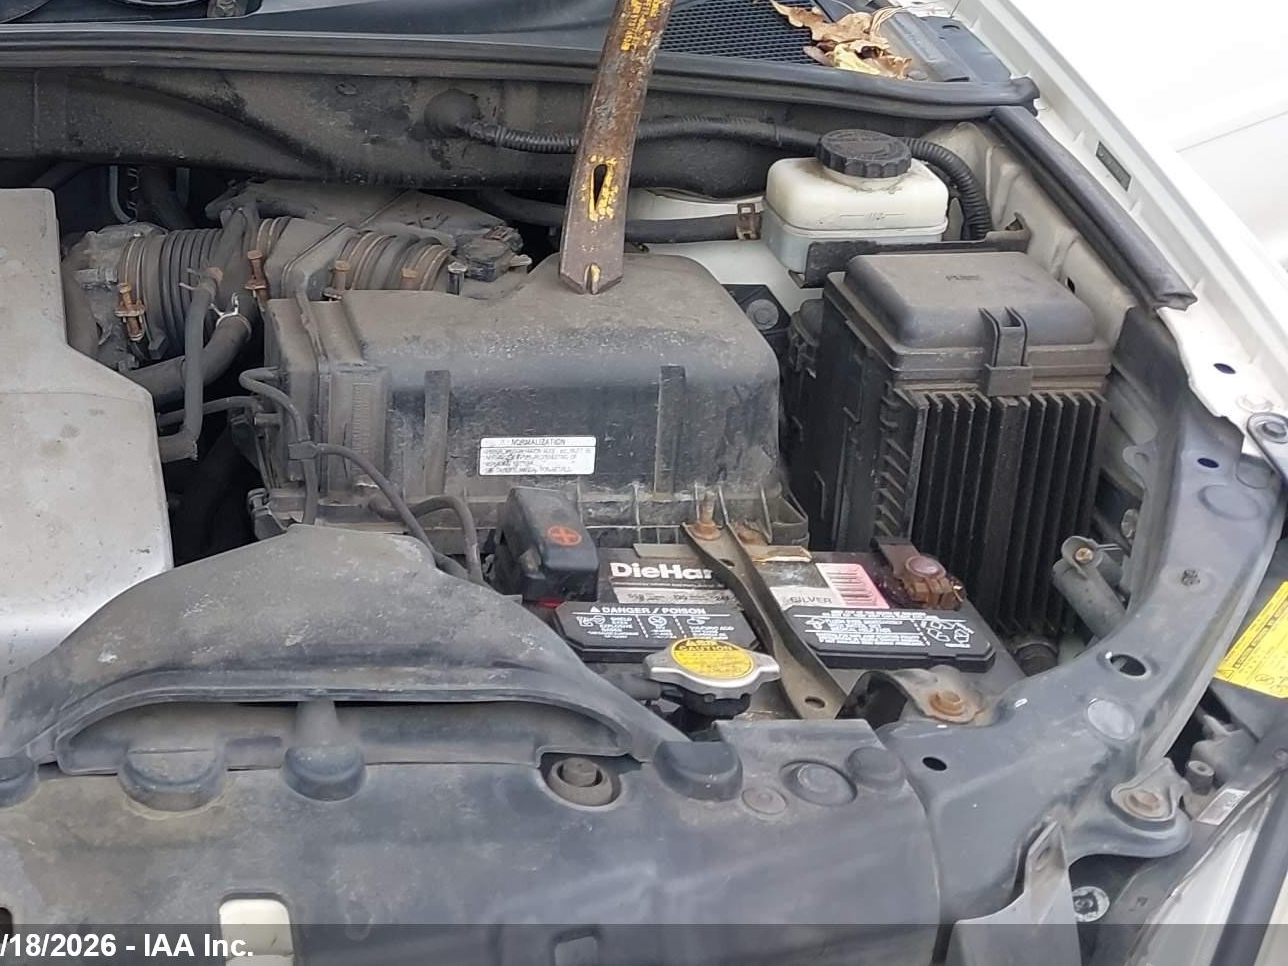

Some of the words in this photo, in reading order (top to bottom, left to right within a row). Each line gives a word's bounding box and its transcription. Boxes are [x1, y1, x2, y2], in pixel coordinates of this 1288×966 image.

[610, 562, 713, 580] DieHar
[602, 606, 651, 614] DANGER
[661, 607, 707, 615] POISON
